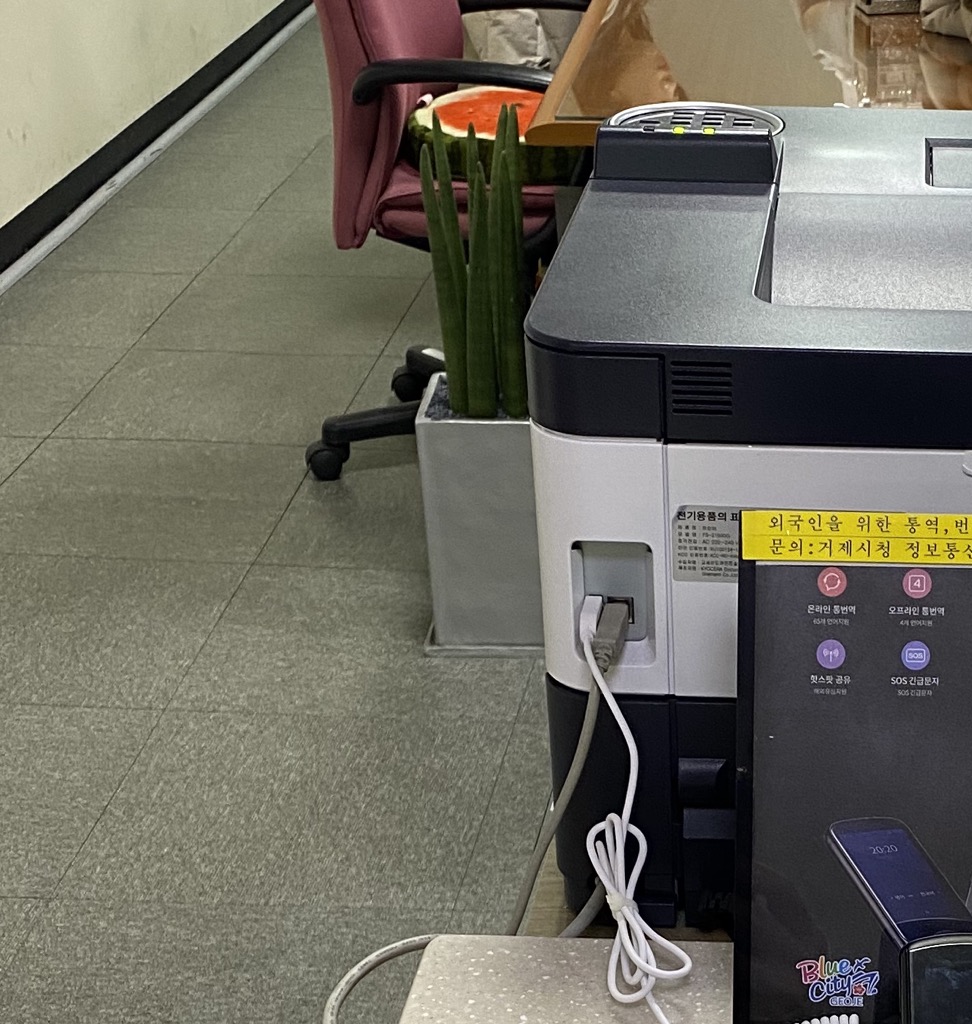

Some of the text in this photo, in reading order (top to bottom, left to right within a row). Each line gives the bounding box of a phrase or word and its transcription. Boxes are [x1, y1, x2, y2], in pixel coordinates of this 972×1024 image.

[768, 513, 843, 532] 외국인을
[856, 515, 892, 533] 위한
[769, 538, 892, 558] 문의:거제시청
[807, 604, 856, 615] 온라인 통번역
[888, 606, 945, 616] 오프라인 통번역
[907, 652, 924, 660] SOS
[835, 675, 851, 685] 공유
[890, 676, 939, 686] SOS 긴급문자
[897, 689, 909, 697] SOS
[796, 955, 852, 984] Blue
[808, 974, 852, 1002] City
[829, 996, 864, 1007] GEOJE
